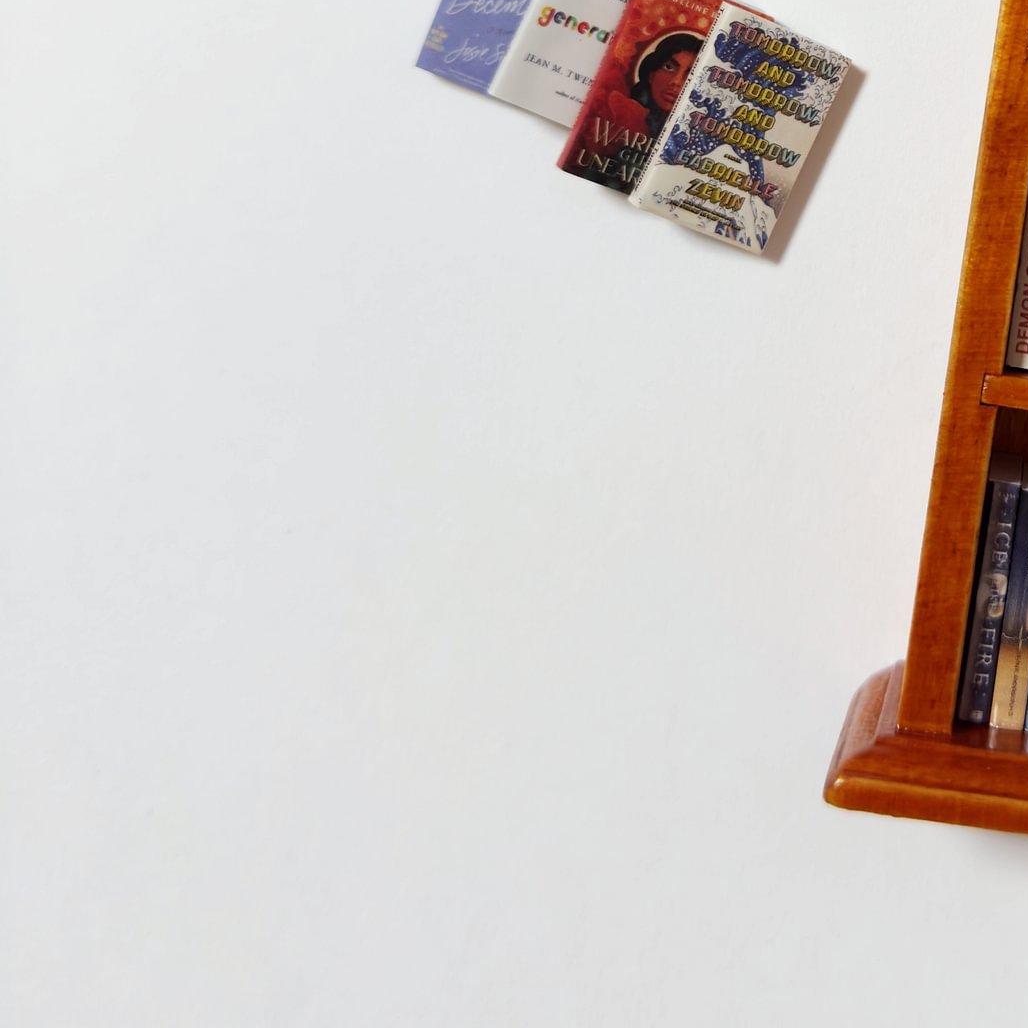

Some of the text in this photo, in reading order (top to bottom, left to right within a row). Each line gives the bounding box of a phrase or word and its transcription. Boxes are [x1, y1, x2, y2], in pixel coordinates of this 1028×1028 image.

[524, 52, 563, 74] JEAN M.
[752, 59, 798, 91] AND
[731, 102, 777, 134] AND
[684, 108, 801, 170] TOMORROW
[673, 145, 779, 203] GABRIELLE
[684, 175, 746, 214] ZEVIN
